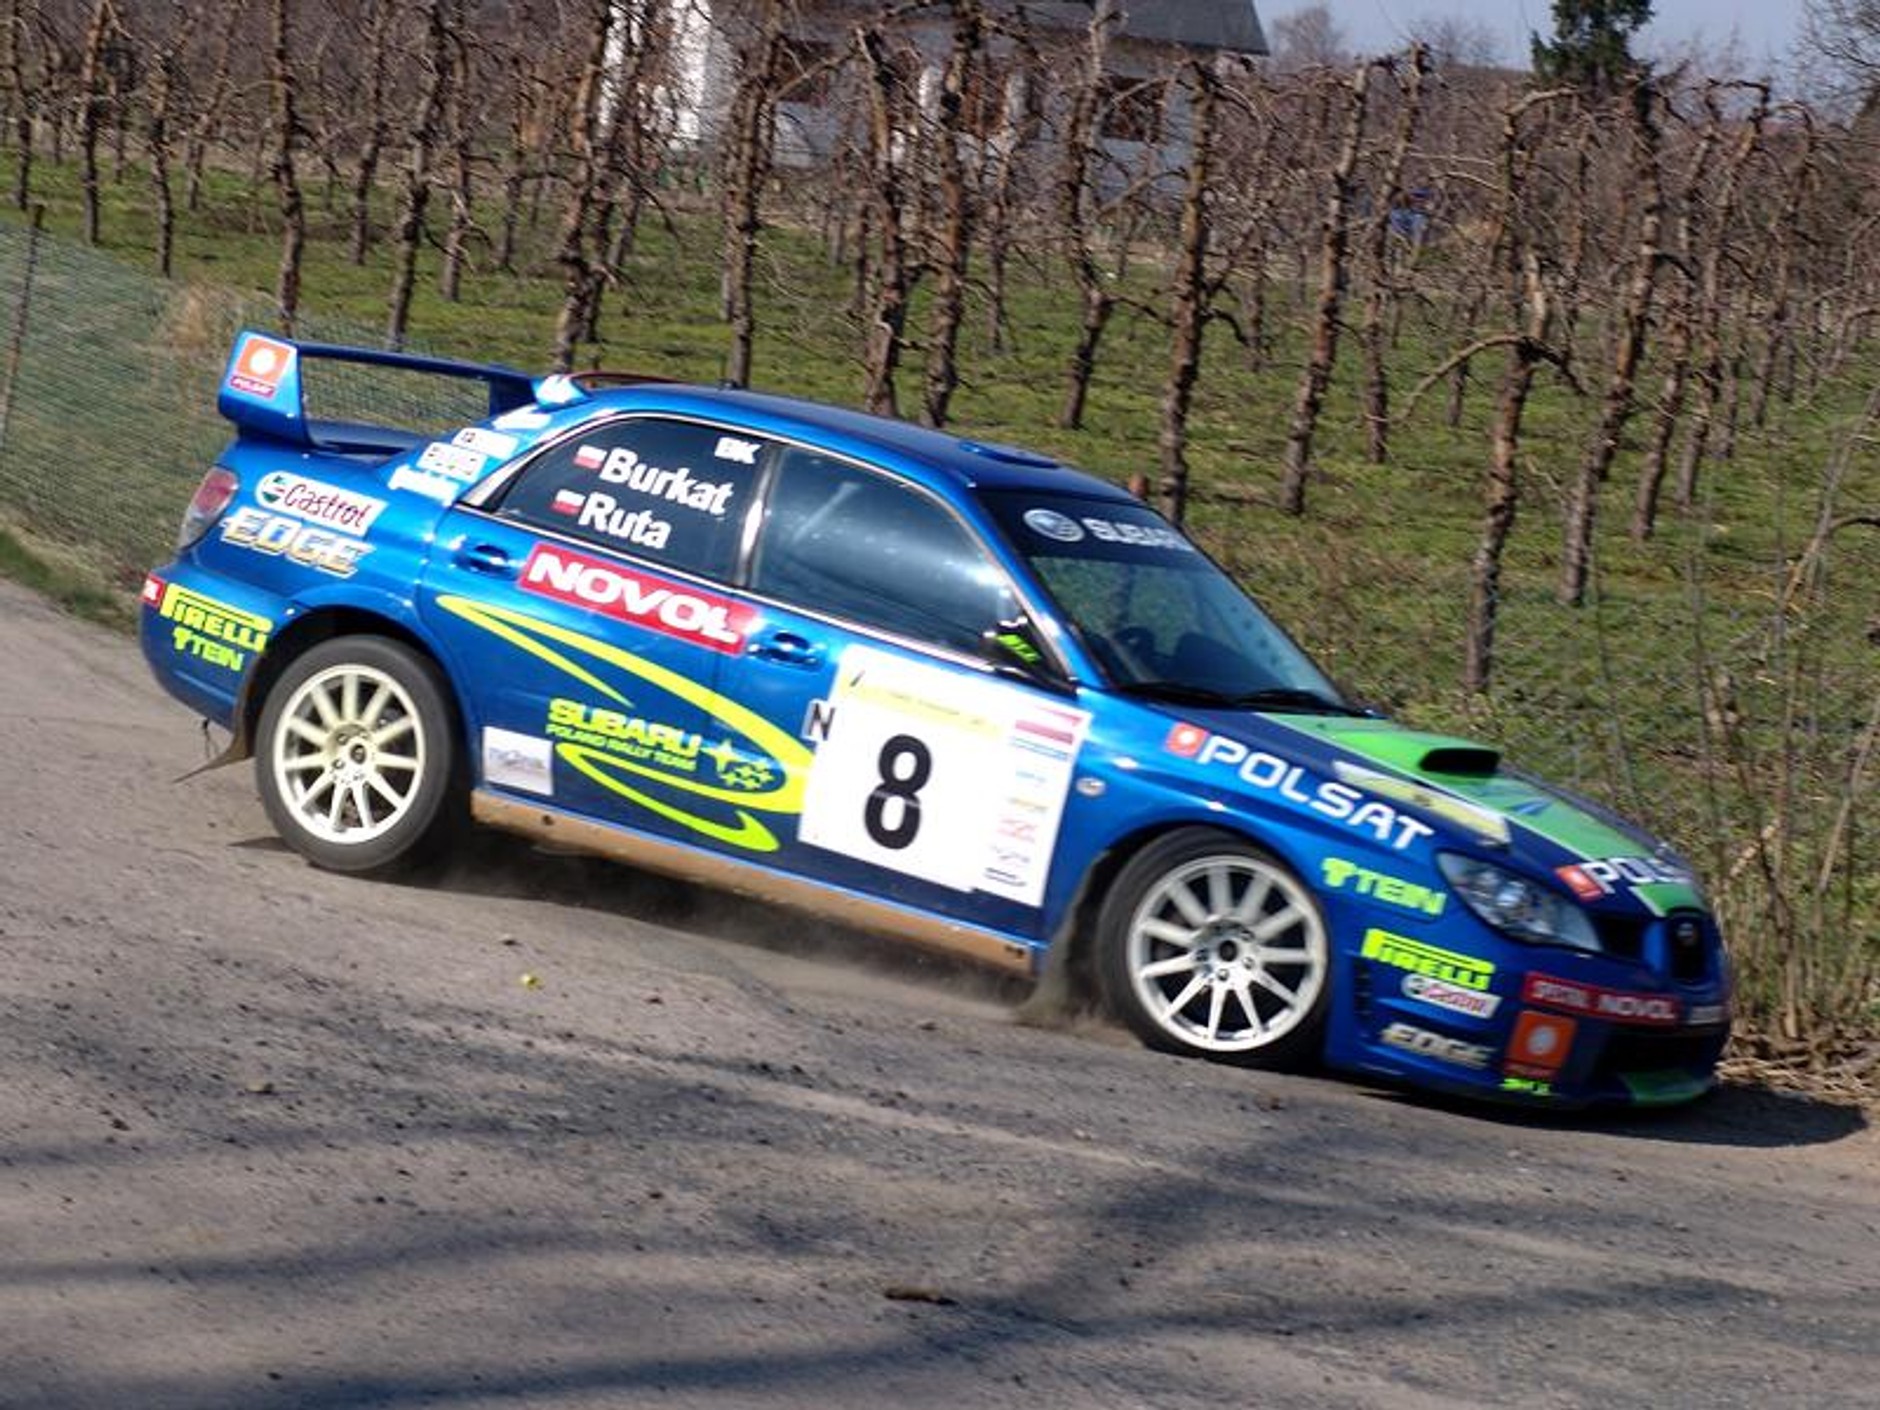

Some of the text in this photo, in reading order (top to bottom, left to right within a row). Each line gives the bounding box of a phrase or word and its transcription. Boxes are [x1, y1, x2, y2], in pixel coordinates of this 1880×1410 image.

[284, 482, 374, 530] Castrol
[599, 447, 734, 515] Burkat
[219, 507, 377, 579] EDGE
[578, 492, 672, 549] Ruta
[159, 582, 273, 653] PIRELLI
[528, 552, 739, 644] NOVOL
[547, 698, 702, 757] SUBARU
[808, 702, 836, 741] N
[863, 733, 932, 850] 8
[1197, 735, 1435, 850] POLSAT
[1361, 928, 1497, 990] PIRELLI
